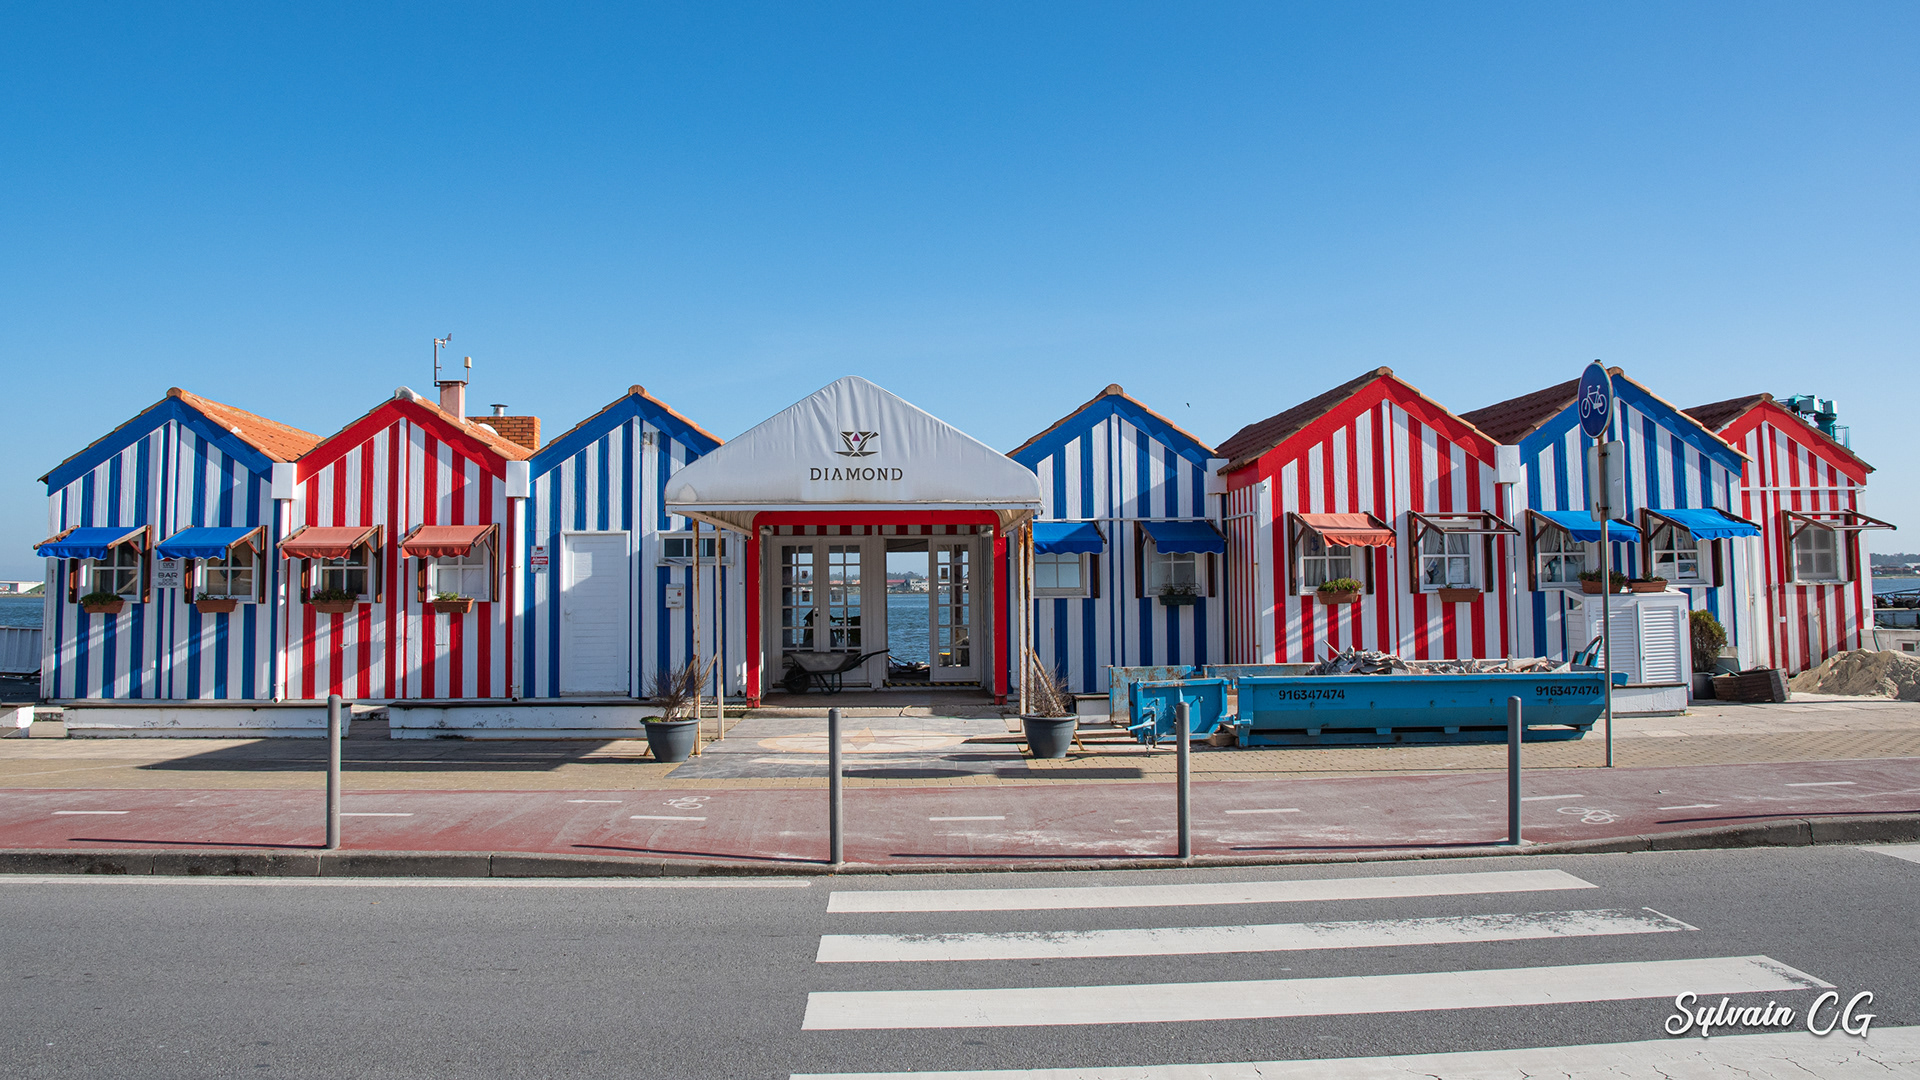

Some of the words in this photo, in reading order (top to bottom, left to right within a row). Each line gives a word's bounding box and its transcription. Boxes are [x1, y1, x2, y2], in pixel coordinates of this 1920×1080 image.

[809, 467, 903, 481] DIAMOND
[1278, 689, 1345, 700] 916347474
[1535, 685, 1600, 696] 916347474
